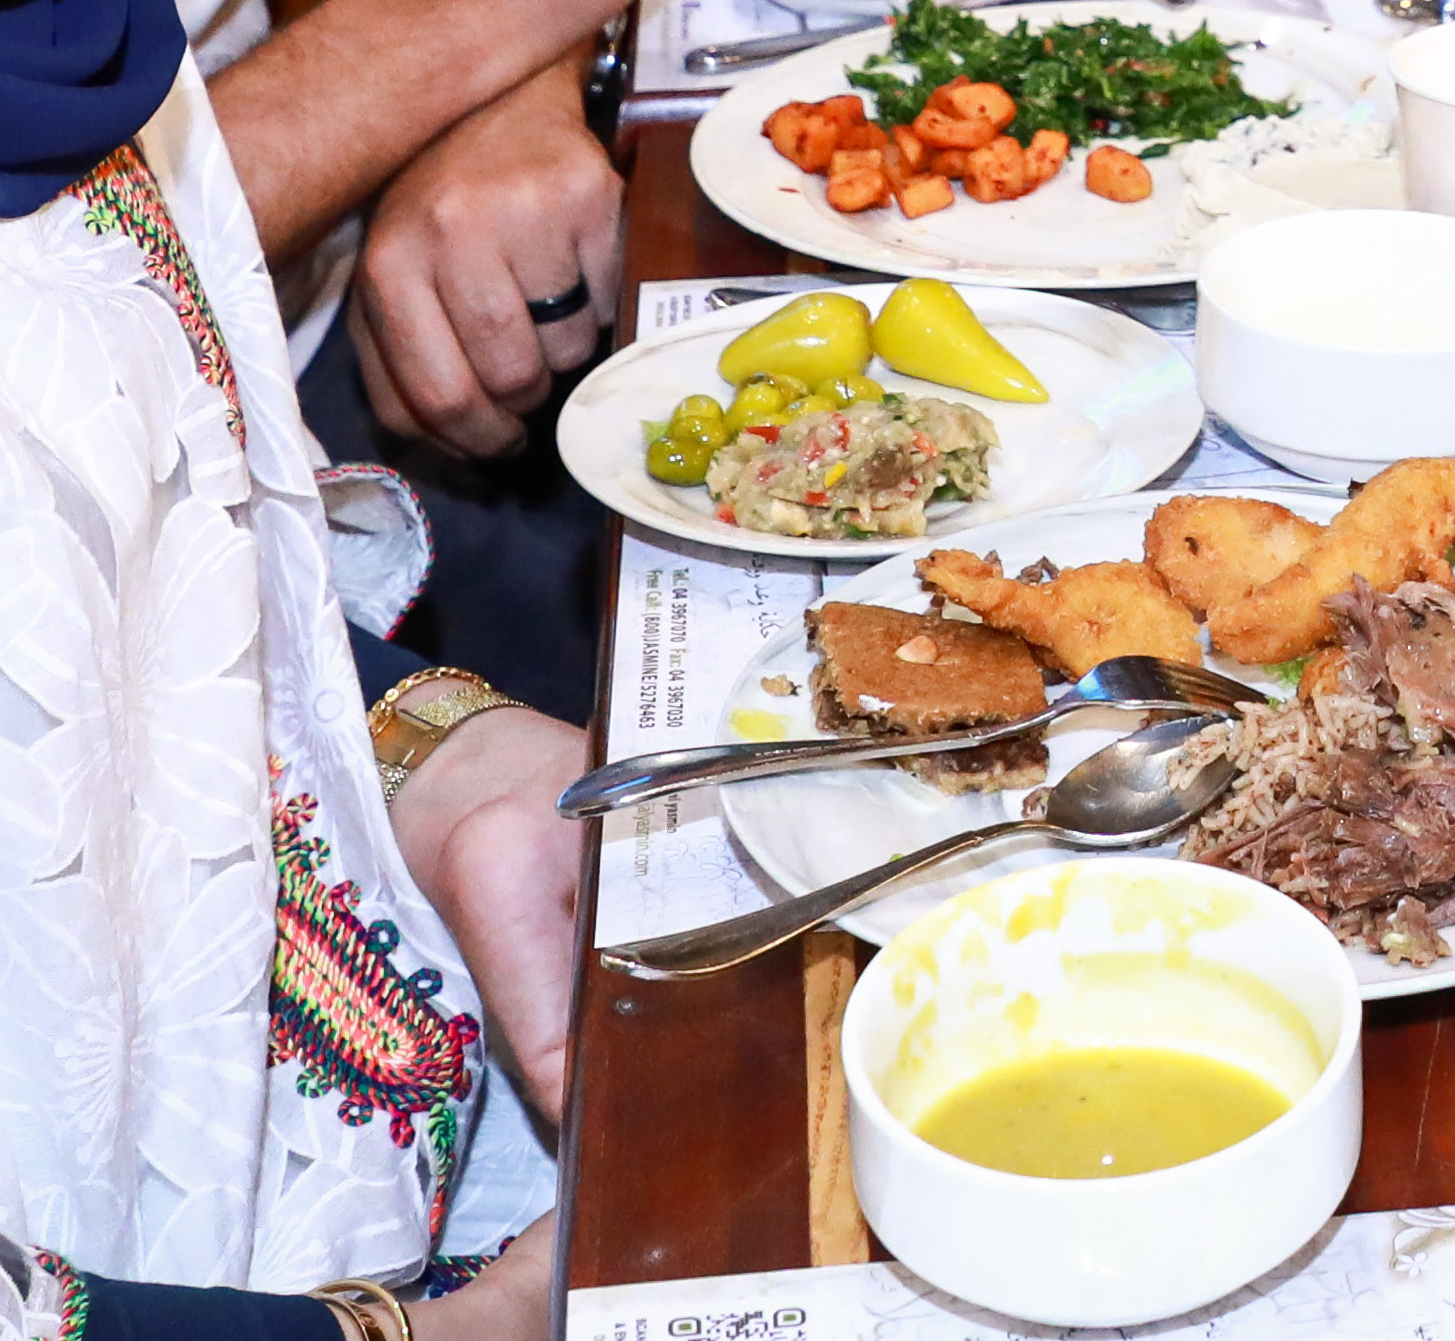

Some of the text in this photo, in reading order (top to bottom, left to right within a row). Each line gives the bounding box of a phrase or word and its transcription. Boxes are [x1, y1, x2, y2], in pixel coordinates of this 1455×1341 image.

[671, 587, 688, 599] 04
[670, 603, 688, 643] 3967070
[668, 669, 686, 682] 04
[666, 686, 685, 728] 3967030
